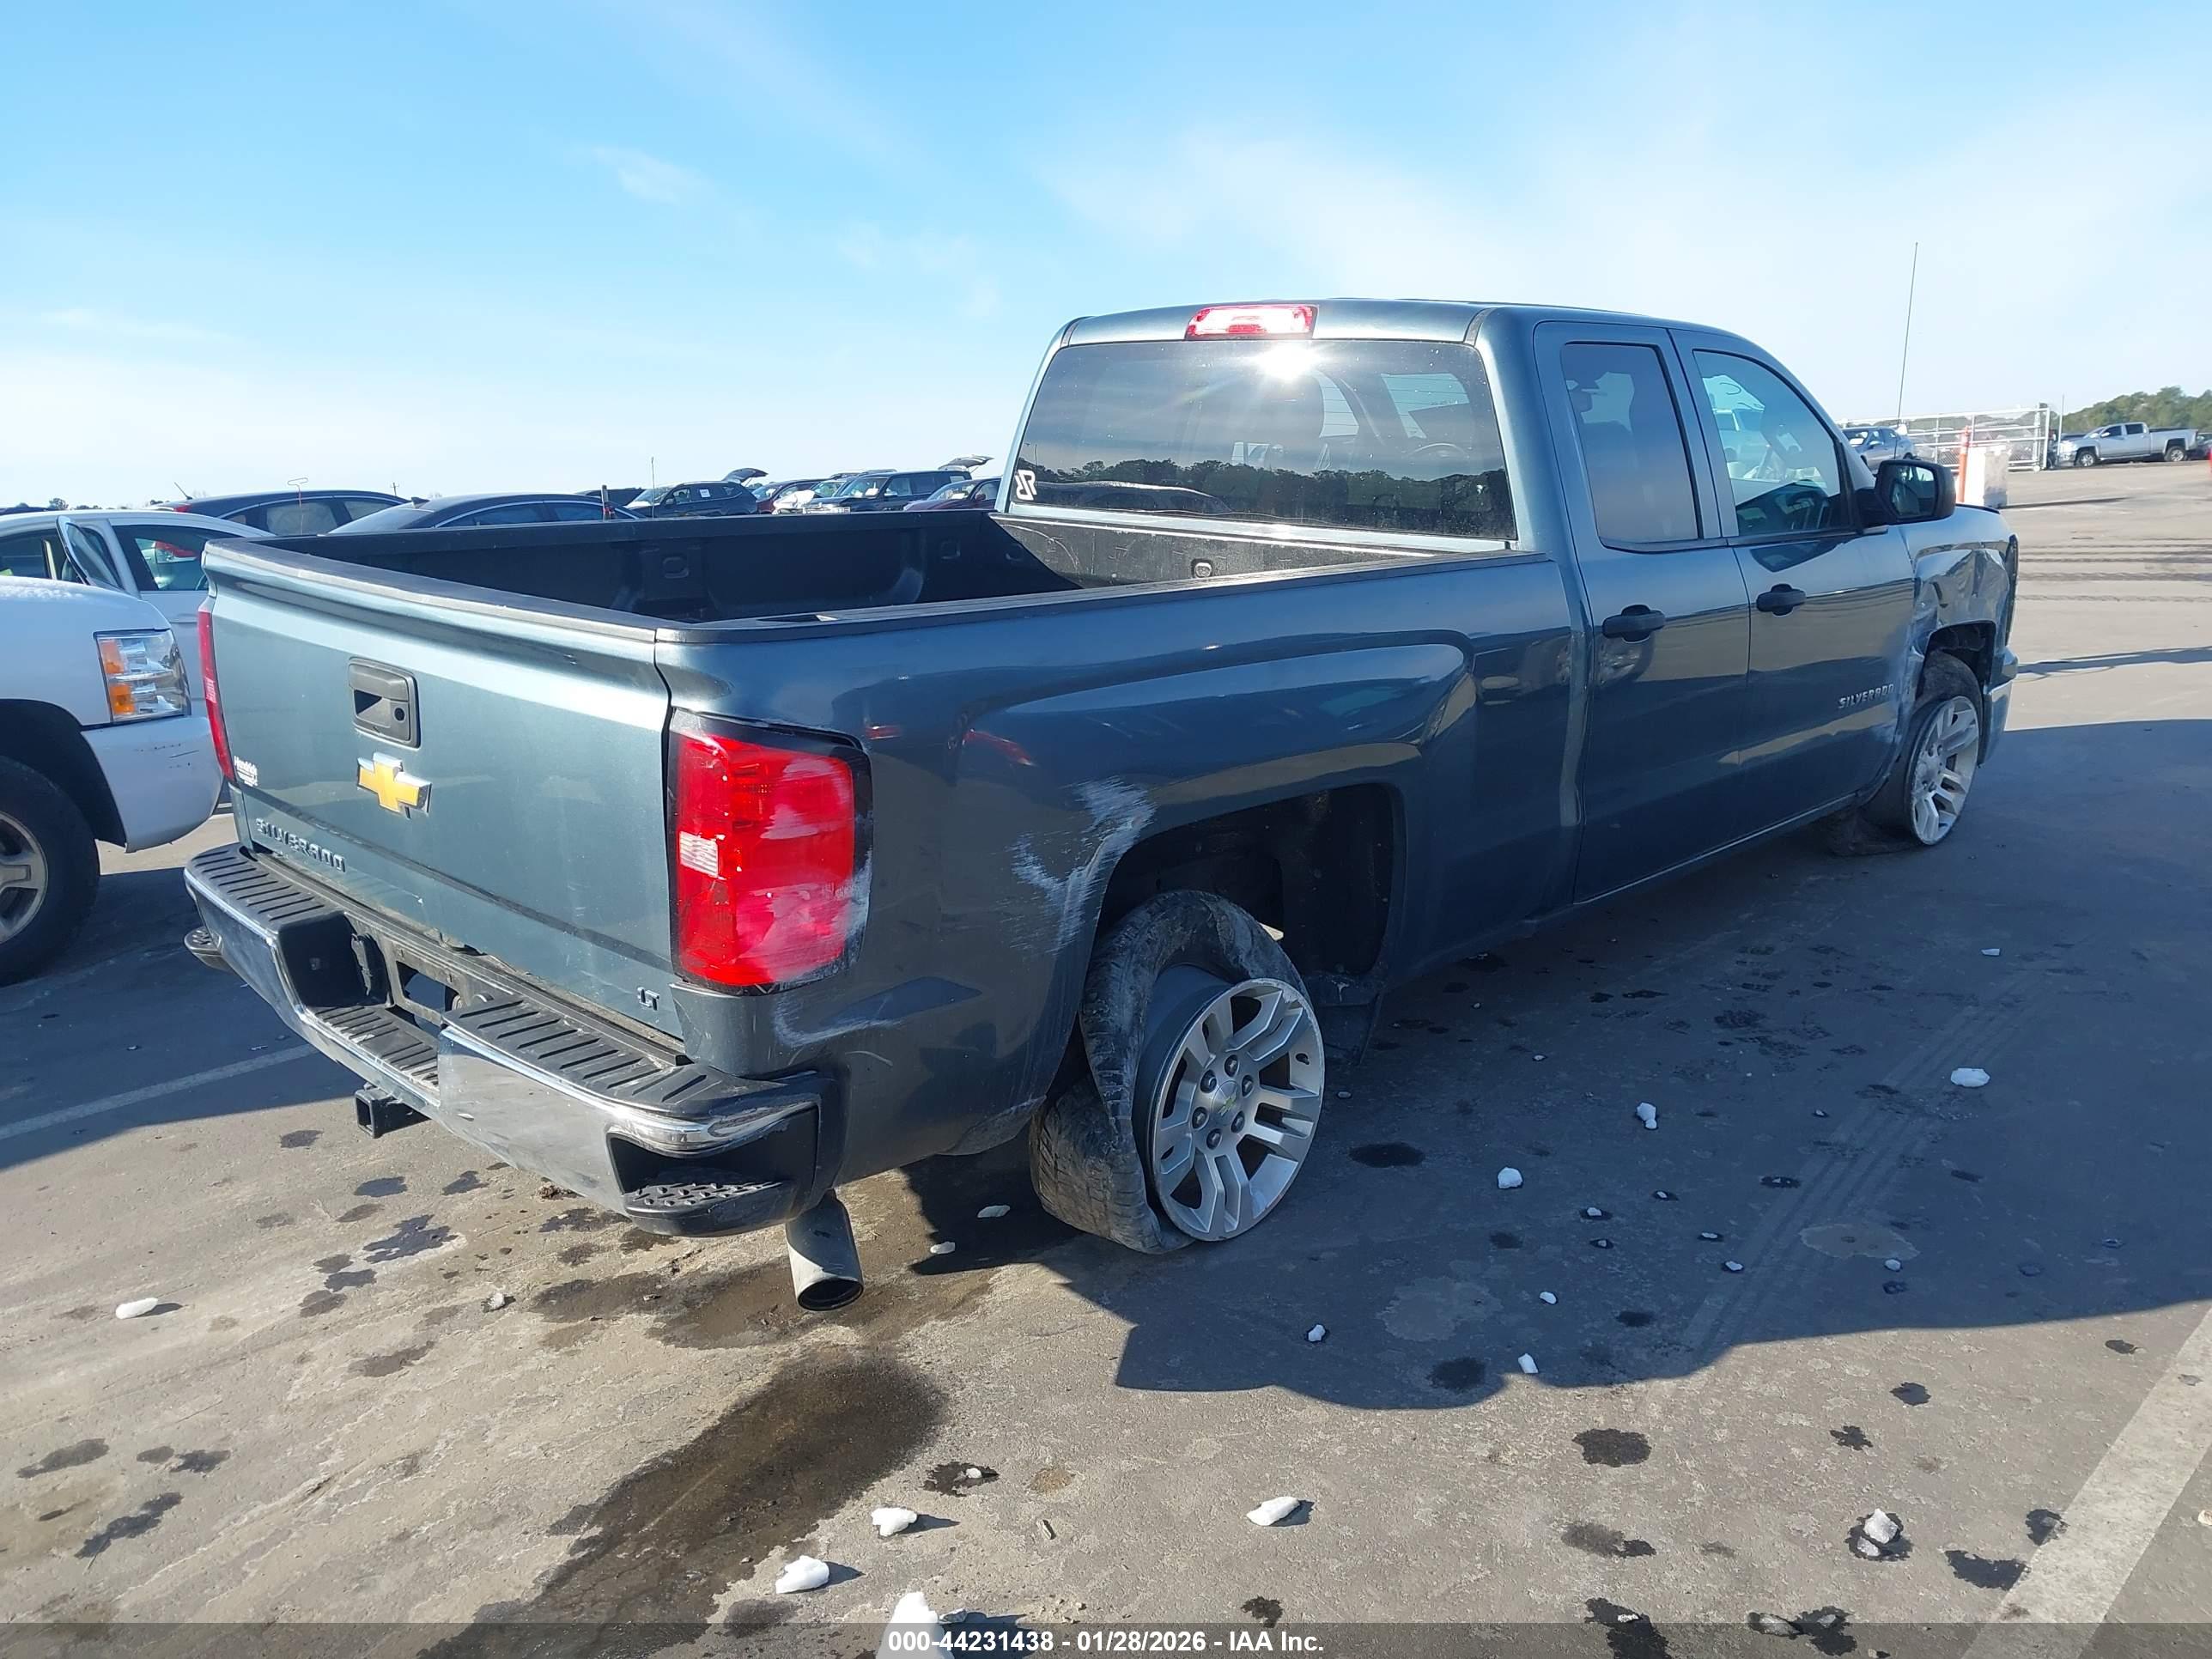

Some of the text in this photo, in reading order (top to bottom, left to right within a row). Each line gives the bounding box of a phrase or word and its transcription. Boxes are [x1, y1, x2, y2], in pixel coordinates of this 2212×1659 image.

[1838, 684, 1894, 708] SILVERADO
[256, 817, 346, 872] SILVERADO
[637, 987, 659, 1011] LT
